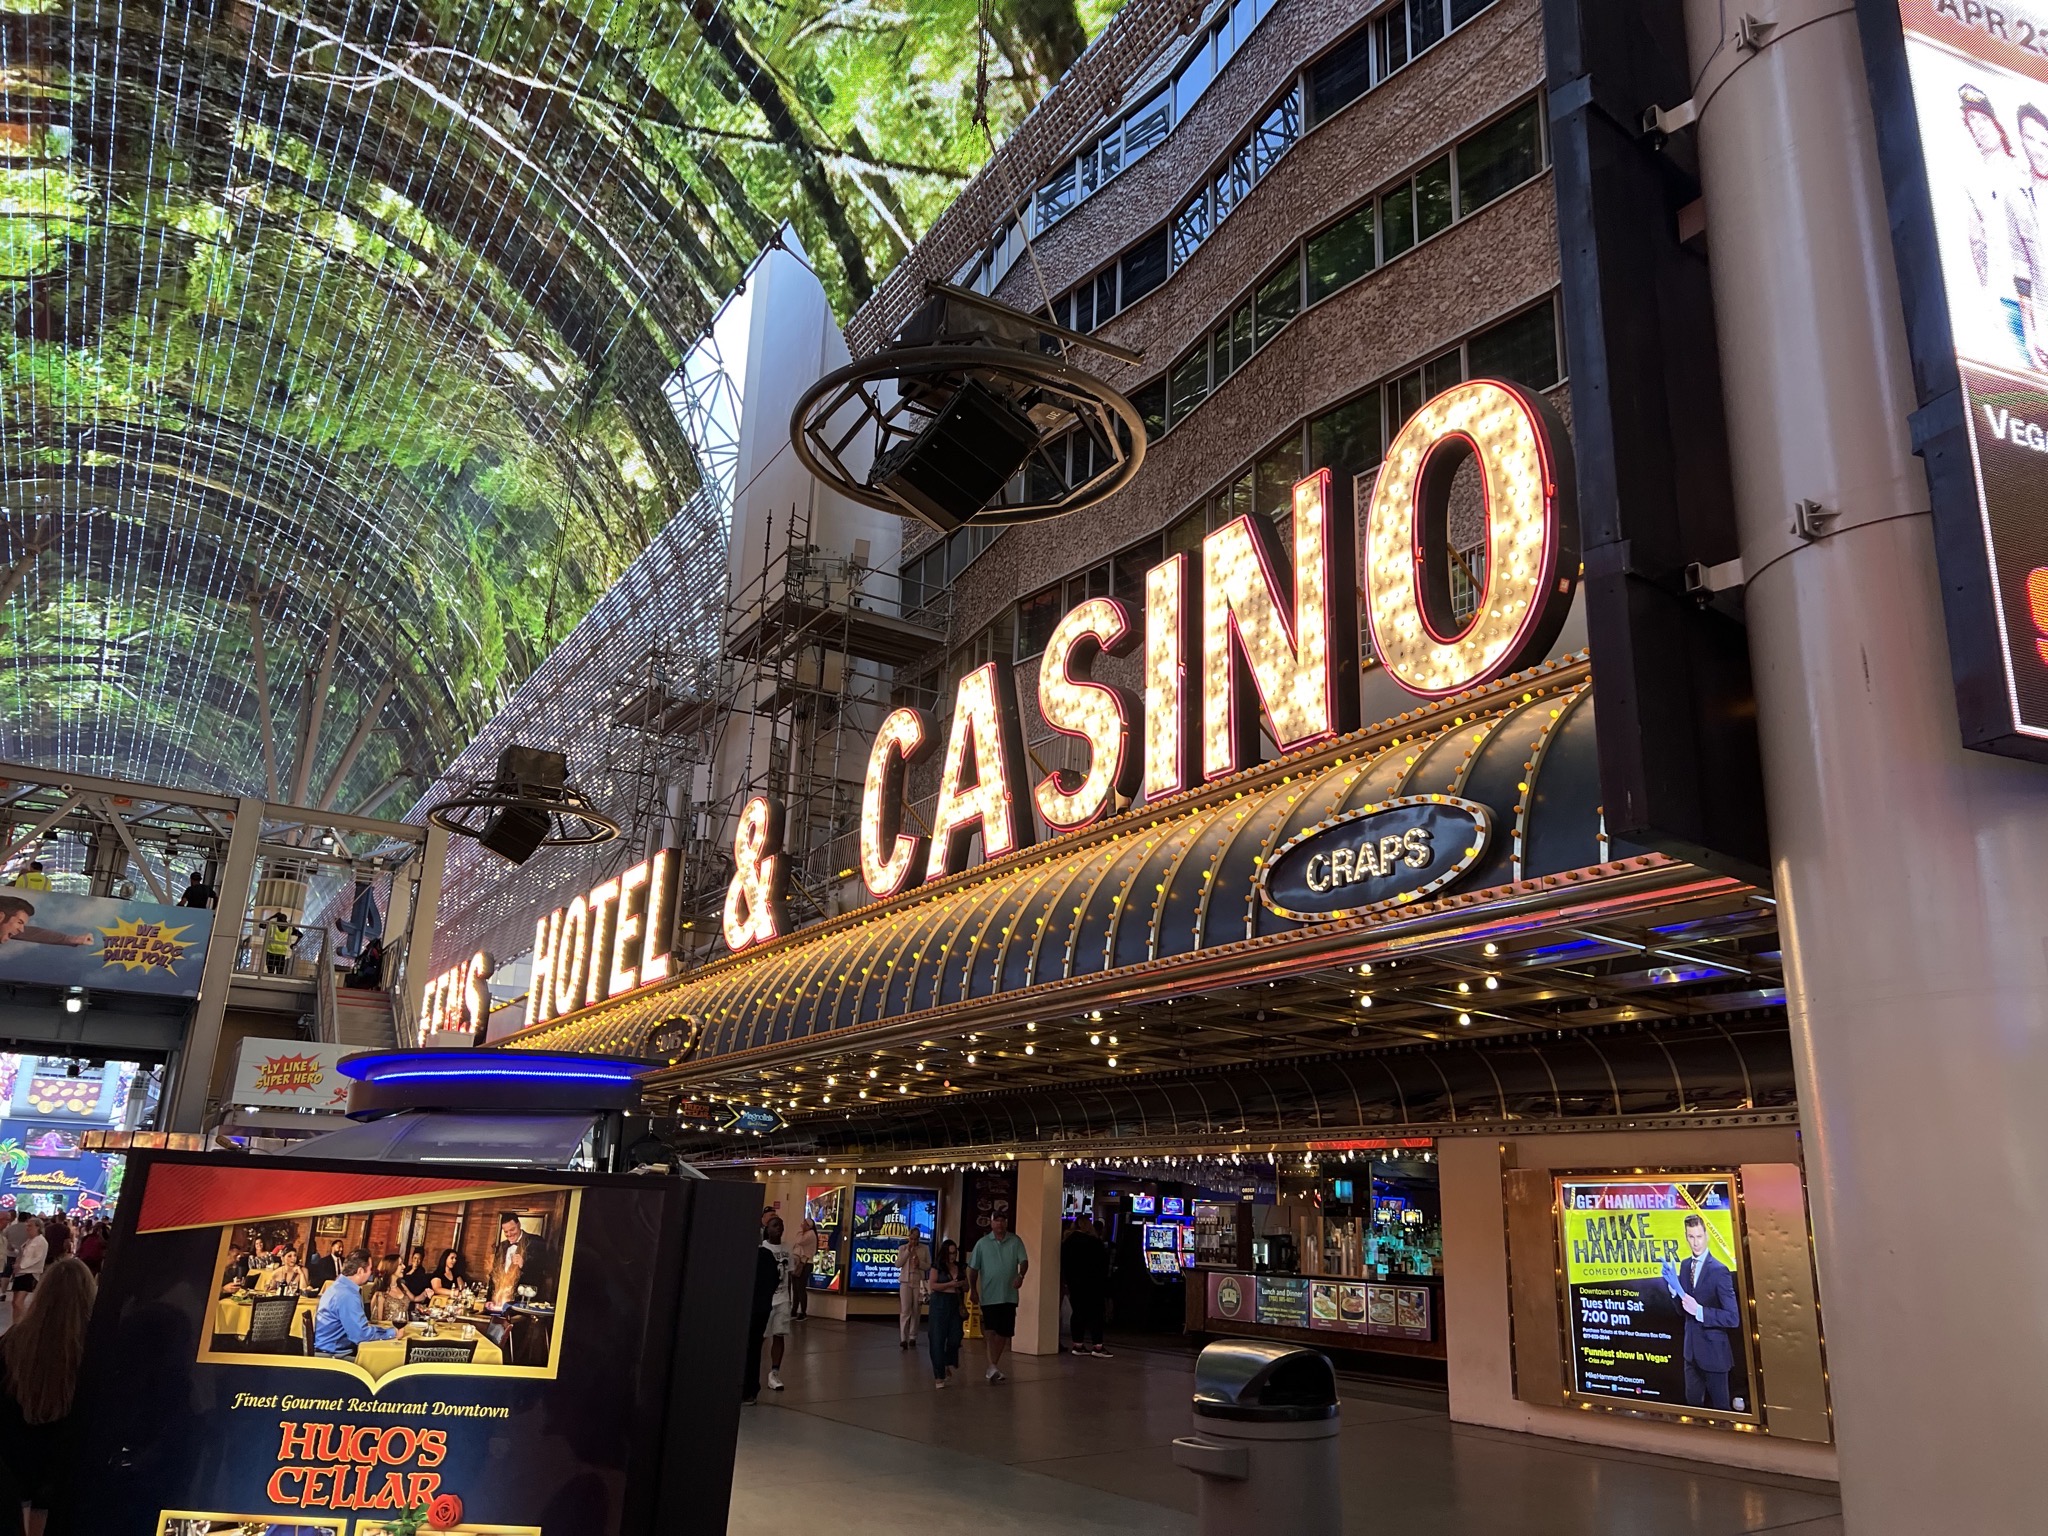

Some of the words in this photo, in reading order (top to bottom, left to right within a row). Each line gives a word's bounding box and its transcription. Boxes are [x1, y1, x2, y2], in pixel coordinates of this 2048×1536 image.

[1983, 404, 2048, 453] VEG
[525, 848, 672, 1028] HOTEL
[723, 796, 784, 952] &
[859, 378, 1560, 898] CASINO
[1306, 827, 1432, 893] CRAPS
[136, 924, 161, 937] WE
[102, 936, 149, 949] TRIPLE
[151, 940, 184, 957] DOG
[103, 949, 138, 962] DARE
[140, 951, 176, 968] YOU!
[261, 1063, 280, 1076] FLY
[283, 1061, 308, 1073] LIKE
[310, 1061, 319, 1072] A
[255, 1073, 291, 1089] SUPER
[293, 1072, 324, 1085] HERO
[892, 1203, 900, 1213] 4
[1576, 1194, 1602, 1209] GET
[884, 1213, 906, 1223] QUEENS
[1585, 1213, 1654, 1241] MIKE
[856, 1253, 871, 1263] NO
[1573, 1239, 1681, 1263] HAMMER
[1583, 1268, 1619, 1276] COMEDY
[1629, 1266, 1658, 1275] MAGIC
[1286, 1289, 1303, 1297] Dinner
[1580, 1287, 1614, 1296] Downtown's
[1622, 1289, 1639, 1297] Show
[1580, 1297, 1603, 1309] Tues
[1604, 1299, 1625, 1310] thru
[1627, 1300, 1644, 1312] Sat
[1581, 1310, 1608, 1323] 7:00
[1610, 1314, 1630, 1326] pm
[1616, 1350, 1635, 1359] show
[231, 1393, 278, 1410] Finest
[281, 1394, 344, 1411] Gourmet
[347, 1398, 428, 1415] Restaurant
[431, 1401, 509, 1418] Downtown
[278, 1421, 447, 1467] HUGO'S
[267, 1465, 441, 1510] CELLAR
